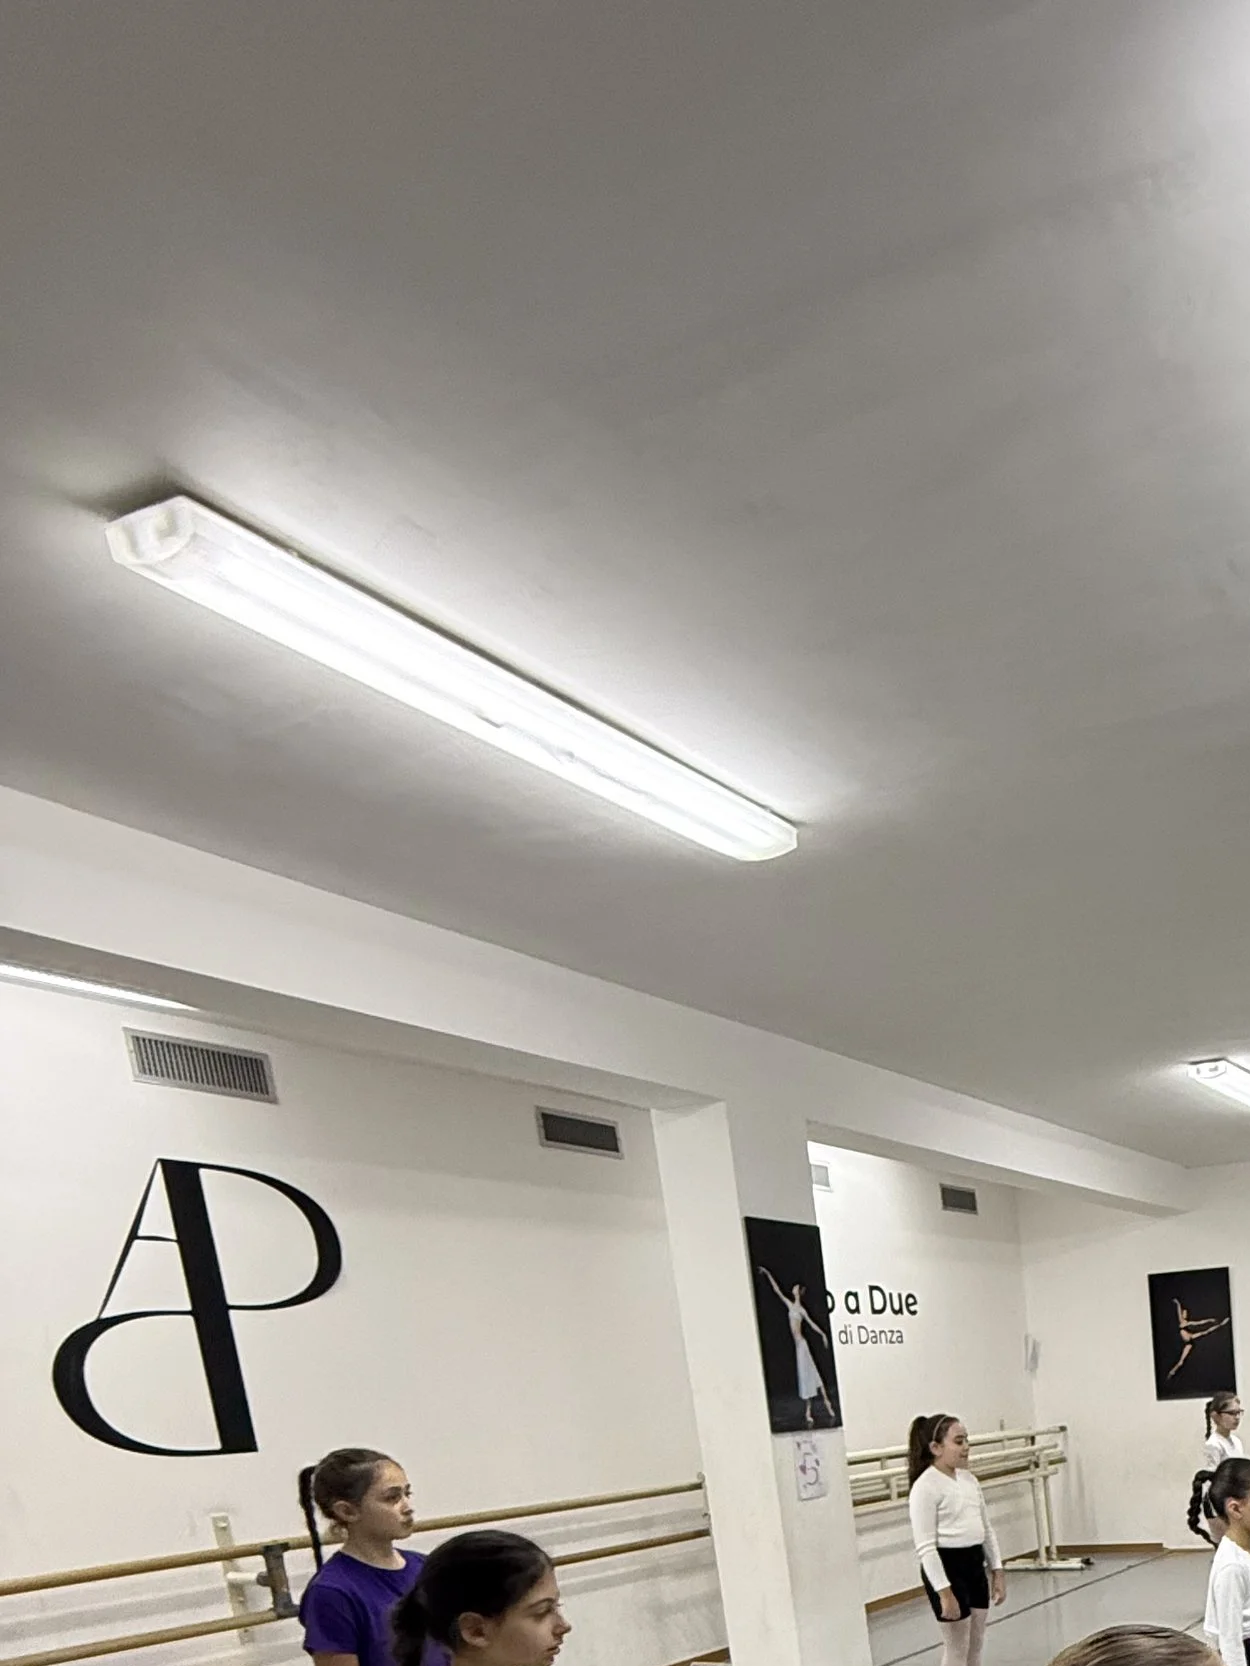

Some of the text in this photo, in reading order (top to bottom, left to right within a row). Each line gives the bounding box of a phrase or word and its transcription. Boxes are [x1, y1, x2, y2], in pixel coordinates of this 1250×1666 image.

[844, 1290, 861, 1315] a
[868, 1284, 918, 1316] Due
[838, 1323, 904, 1345] di Danza
